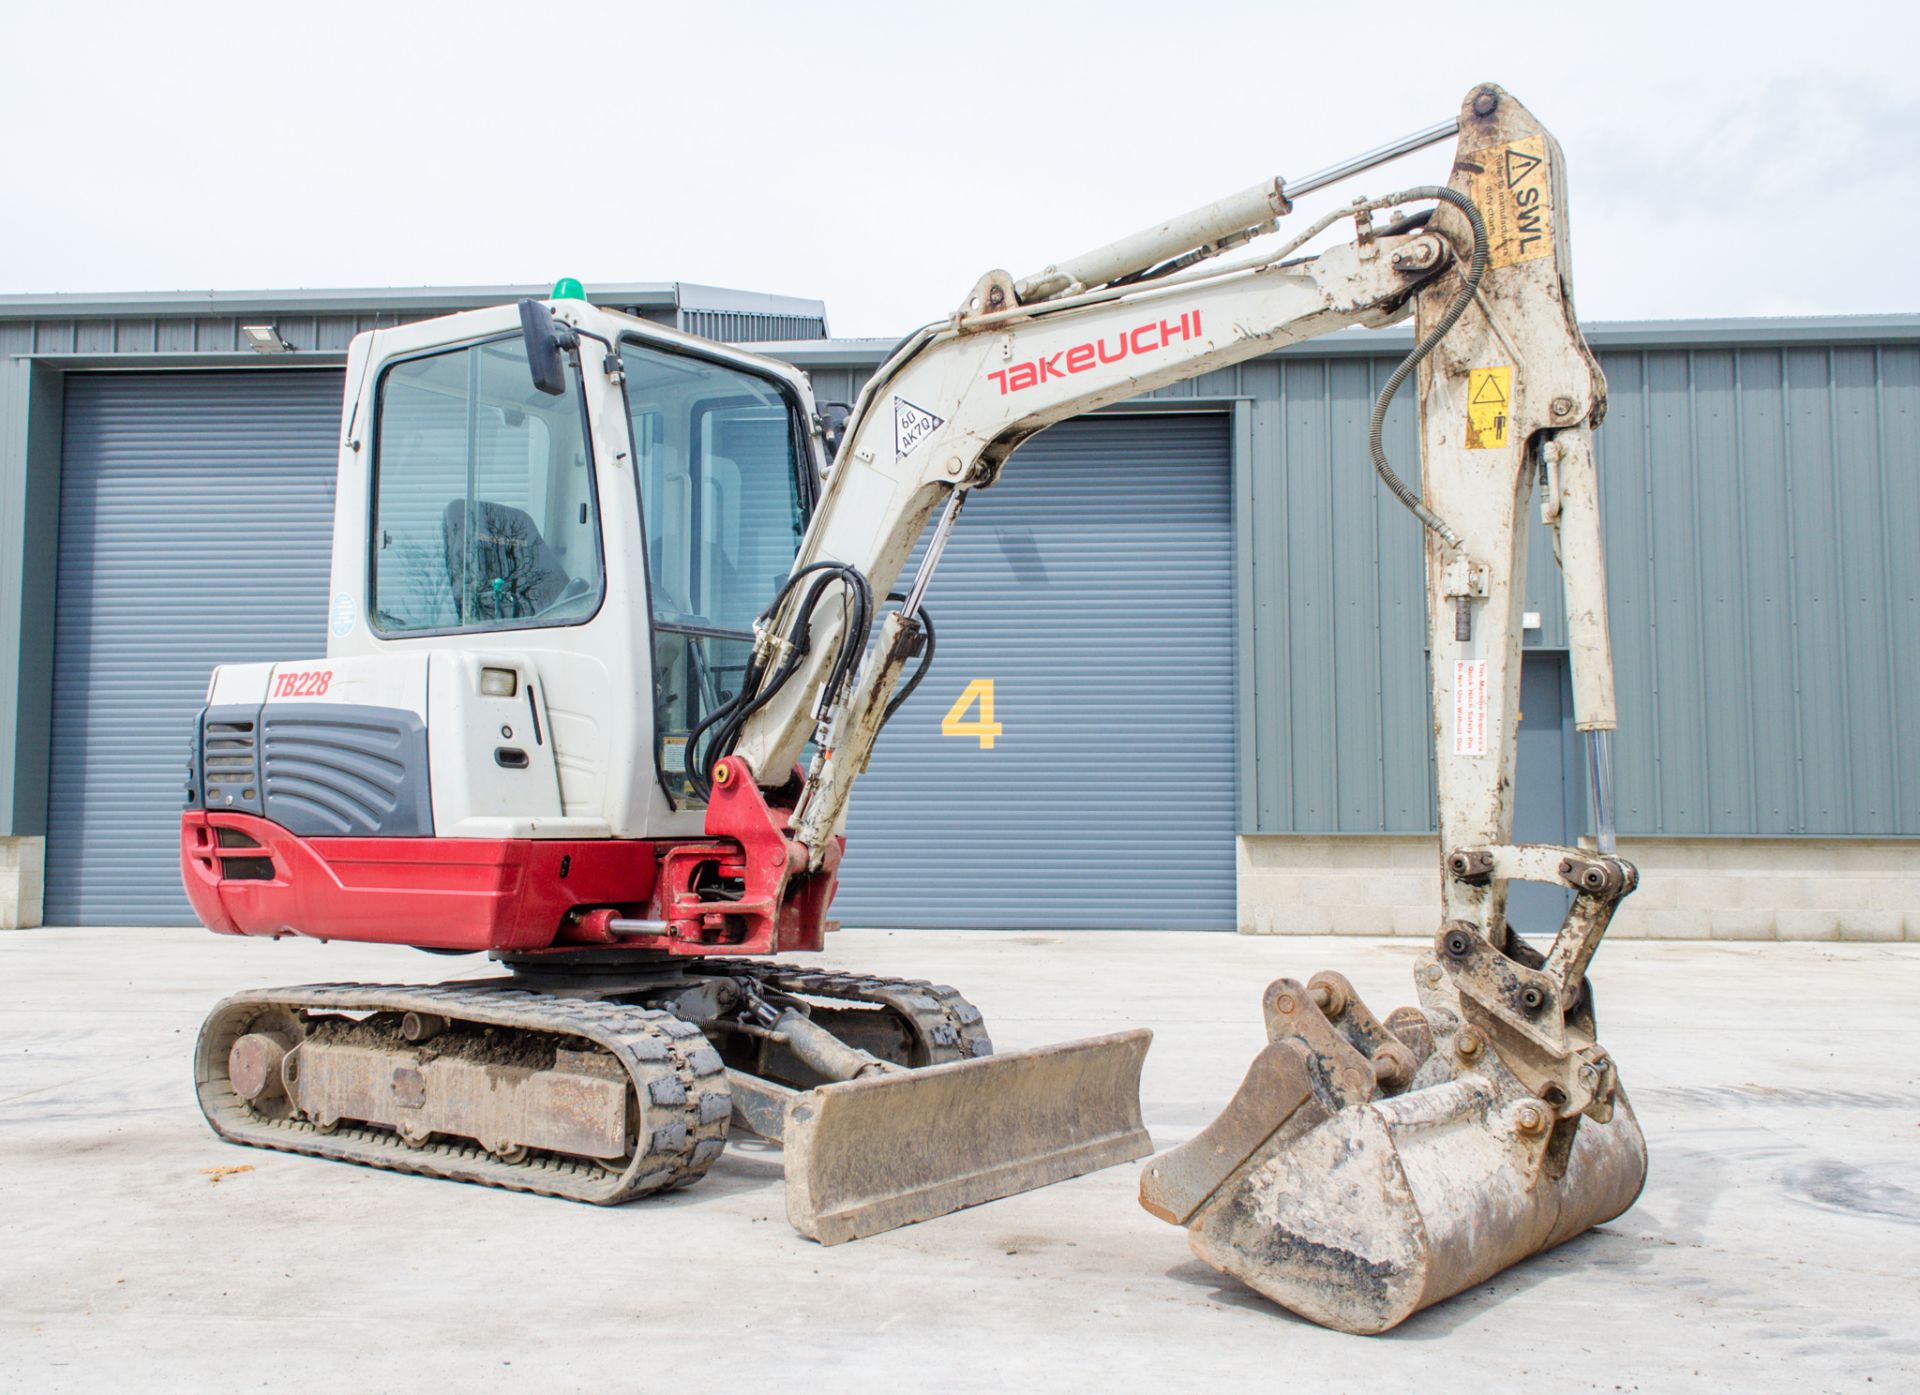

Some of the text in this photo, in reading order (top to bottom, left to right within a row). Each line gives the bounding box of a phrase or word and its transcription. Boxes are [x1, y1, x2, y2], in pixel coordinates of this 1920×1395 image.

[1486, 186, 1496, 236] duty charts
[1516, 187, 1542, 255] SWL
[987, 309, 1202, 396] TAKEUCHI
[274, 670, 333, 698] TB228
[941, 679, 1003, 749] 4
